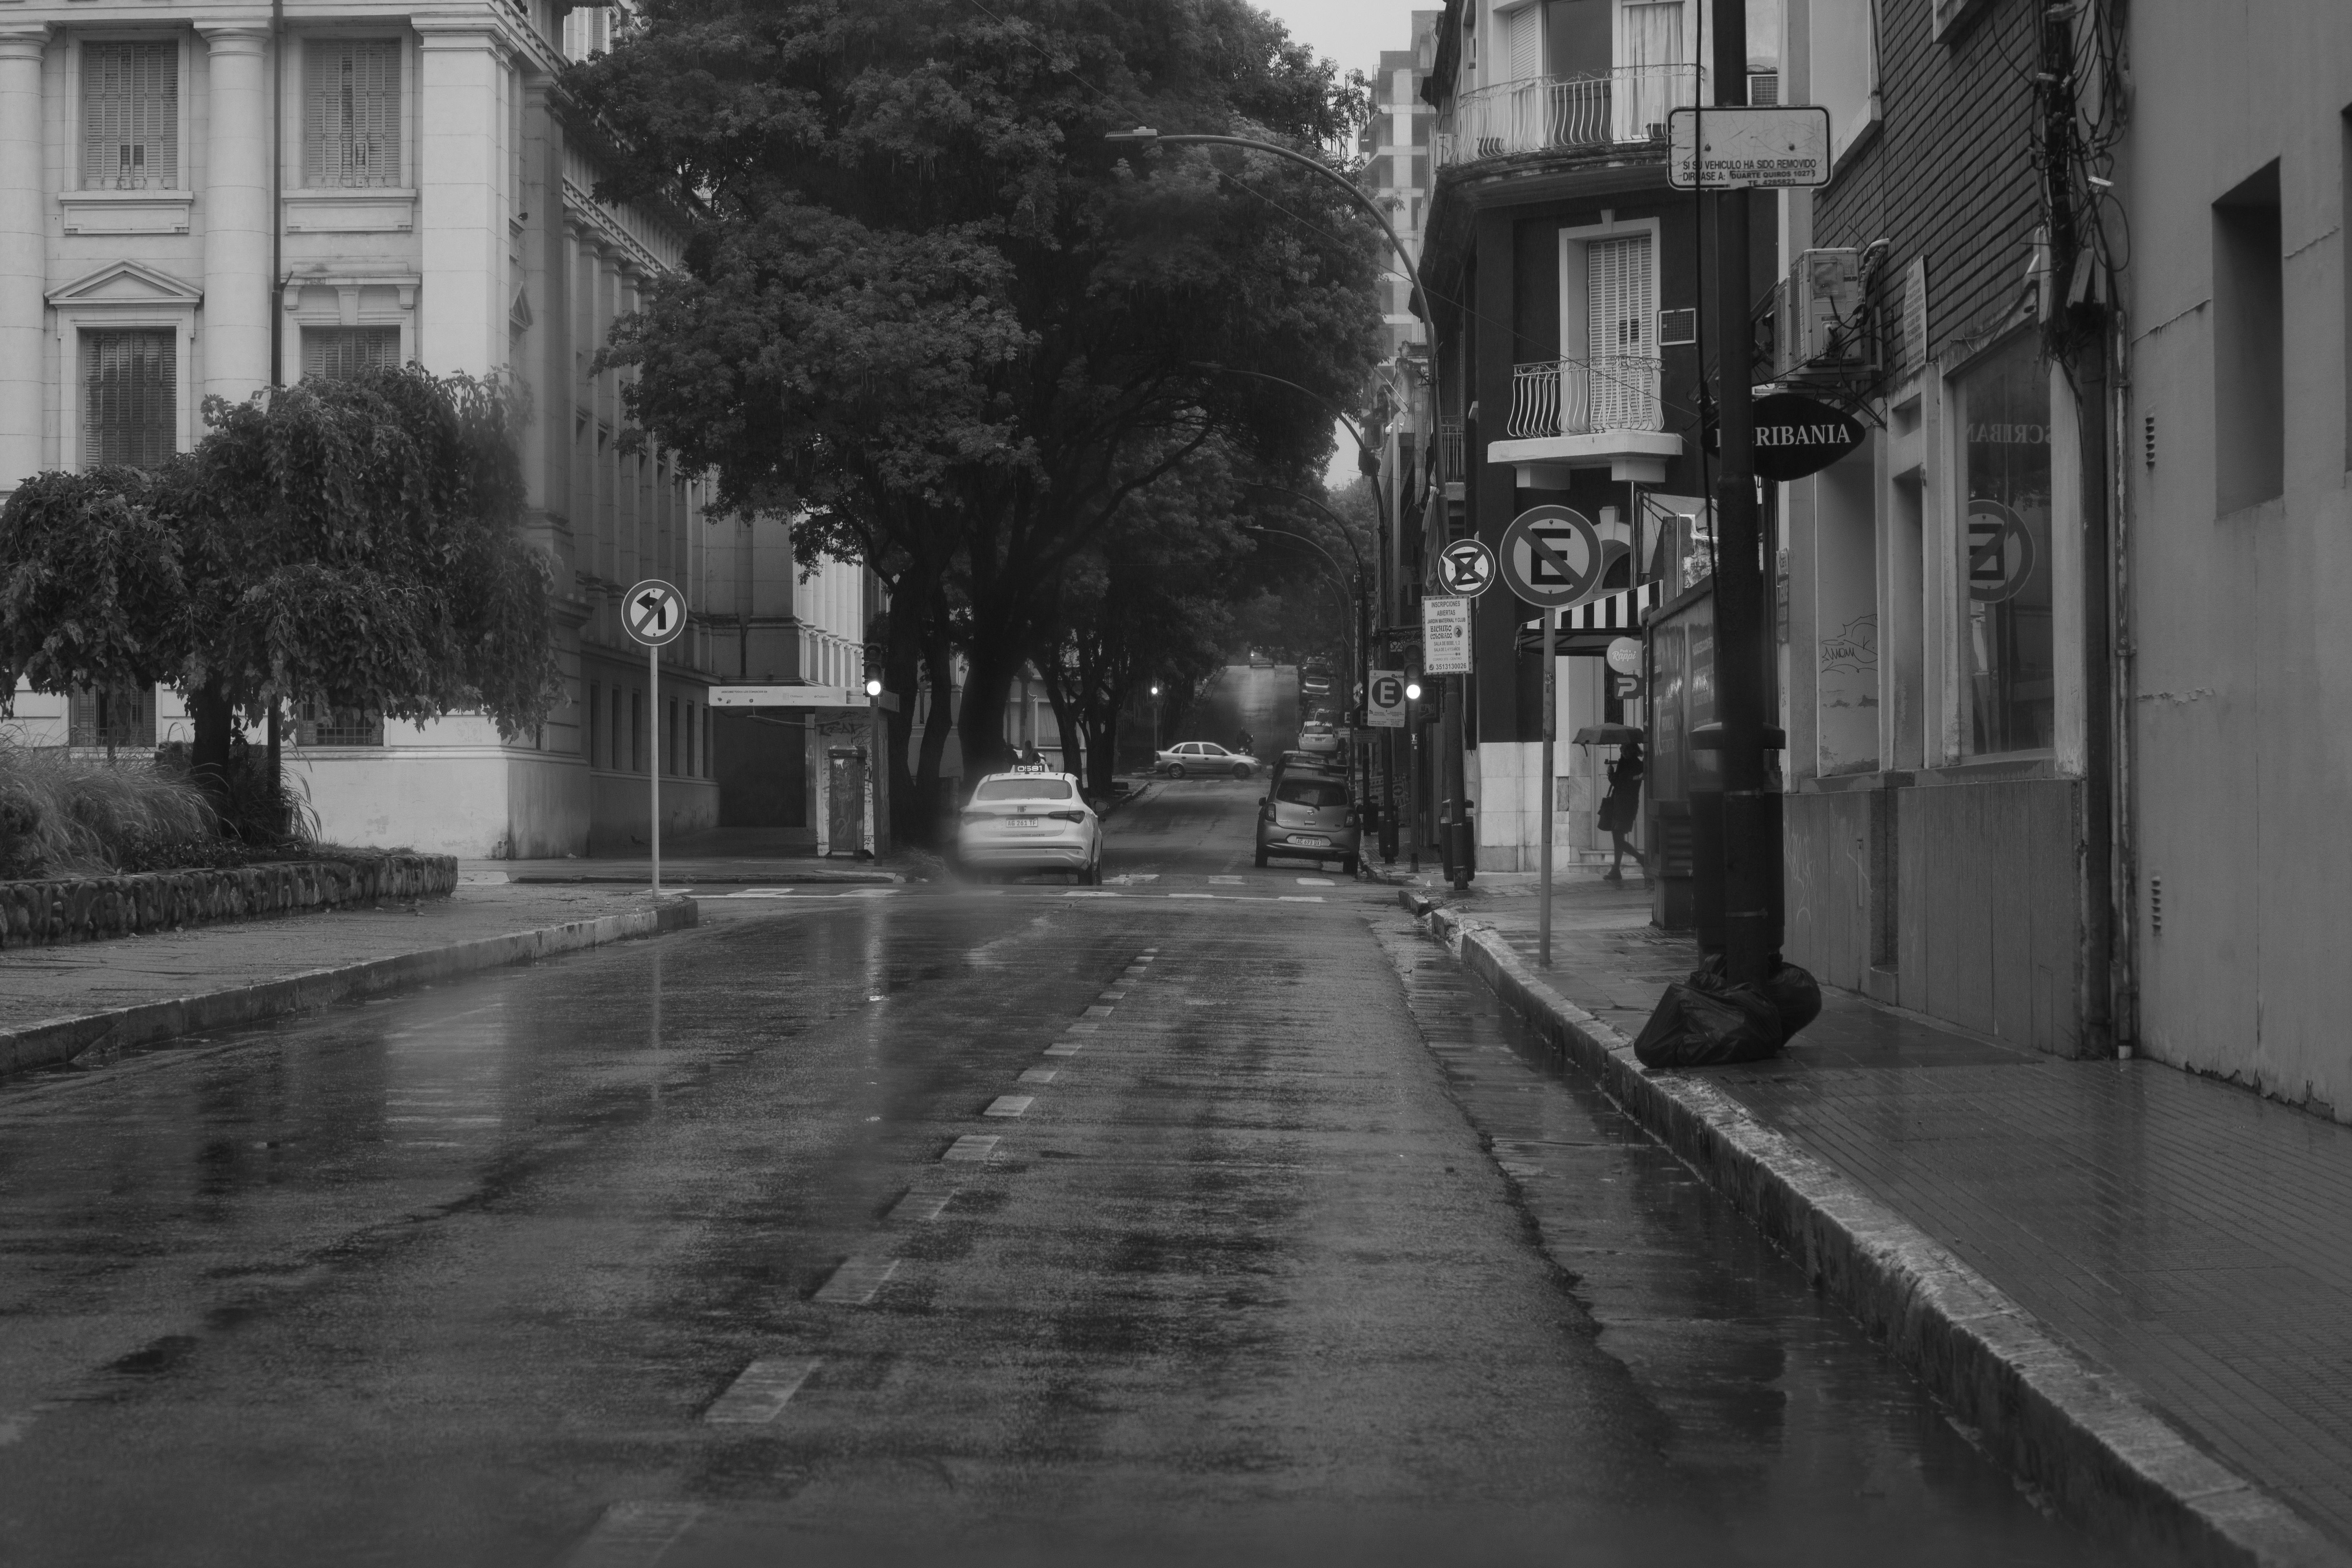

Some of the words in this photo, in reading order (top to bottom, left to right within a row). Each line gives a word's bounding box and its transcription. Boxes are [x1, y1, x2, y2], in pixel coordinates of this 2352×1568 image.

[1683, 161, 1690, 170] SI
[1705, 160, 1741, 169] VEHICULO
[1744, 160, 1754, 169] HA
[1757, 160, 1774, 169] SIDO
[1778, 159, 1817, 169] REMOVIDO
[1683, 171, 1715, 181] DIRASE
[1718, 171, 1726, 180] A:
[1715, 423, 1851, 447] RIBANIA
[1612, 651, 1637, 662] Rappi
[1380, 682, 1396, 703] E
